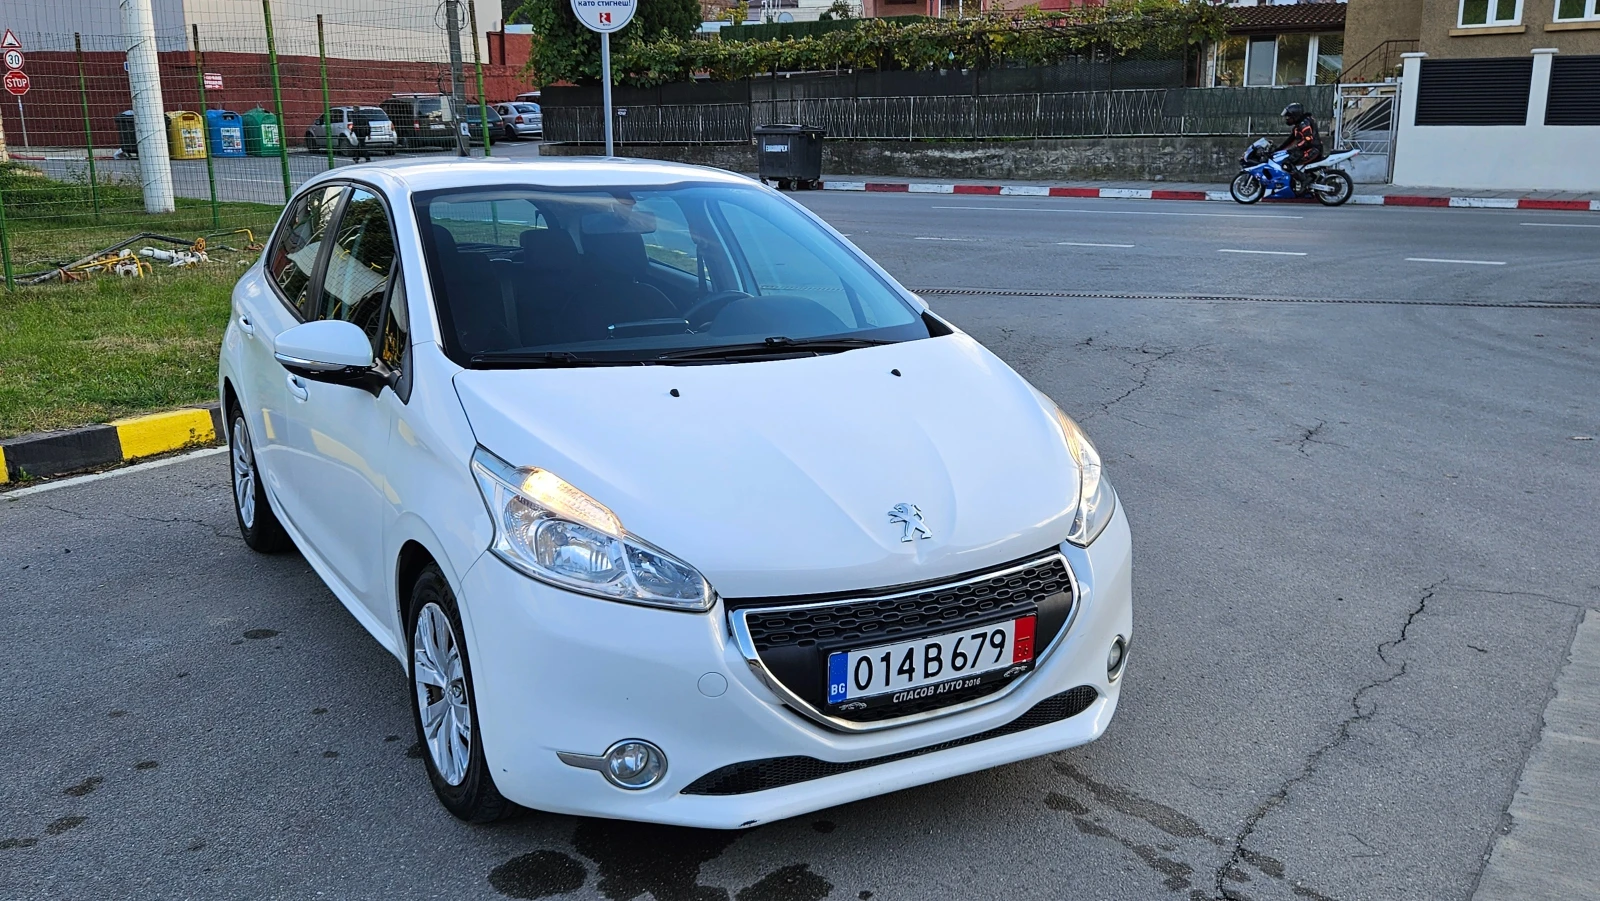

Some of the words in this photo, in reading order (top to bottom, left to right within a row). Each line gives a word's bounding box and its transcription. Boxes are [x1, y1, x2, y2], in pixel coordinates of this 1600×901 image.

[7, 54, 20, 65] 30
[7, 78, 27, 88] STOP
[831, 683, 846, 695] BG
[892, 686, 934, 703] СПАСОВ
[964, 677, 981, 688] 2016
